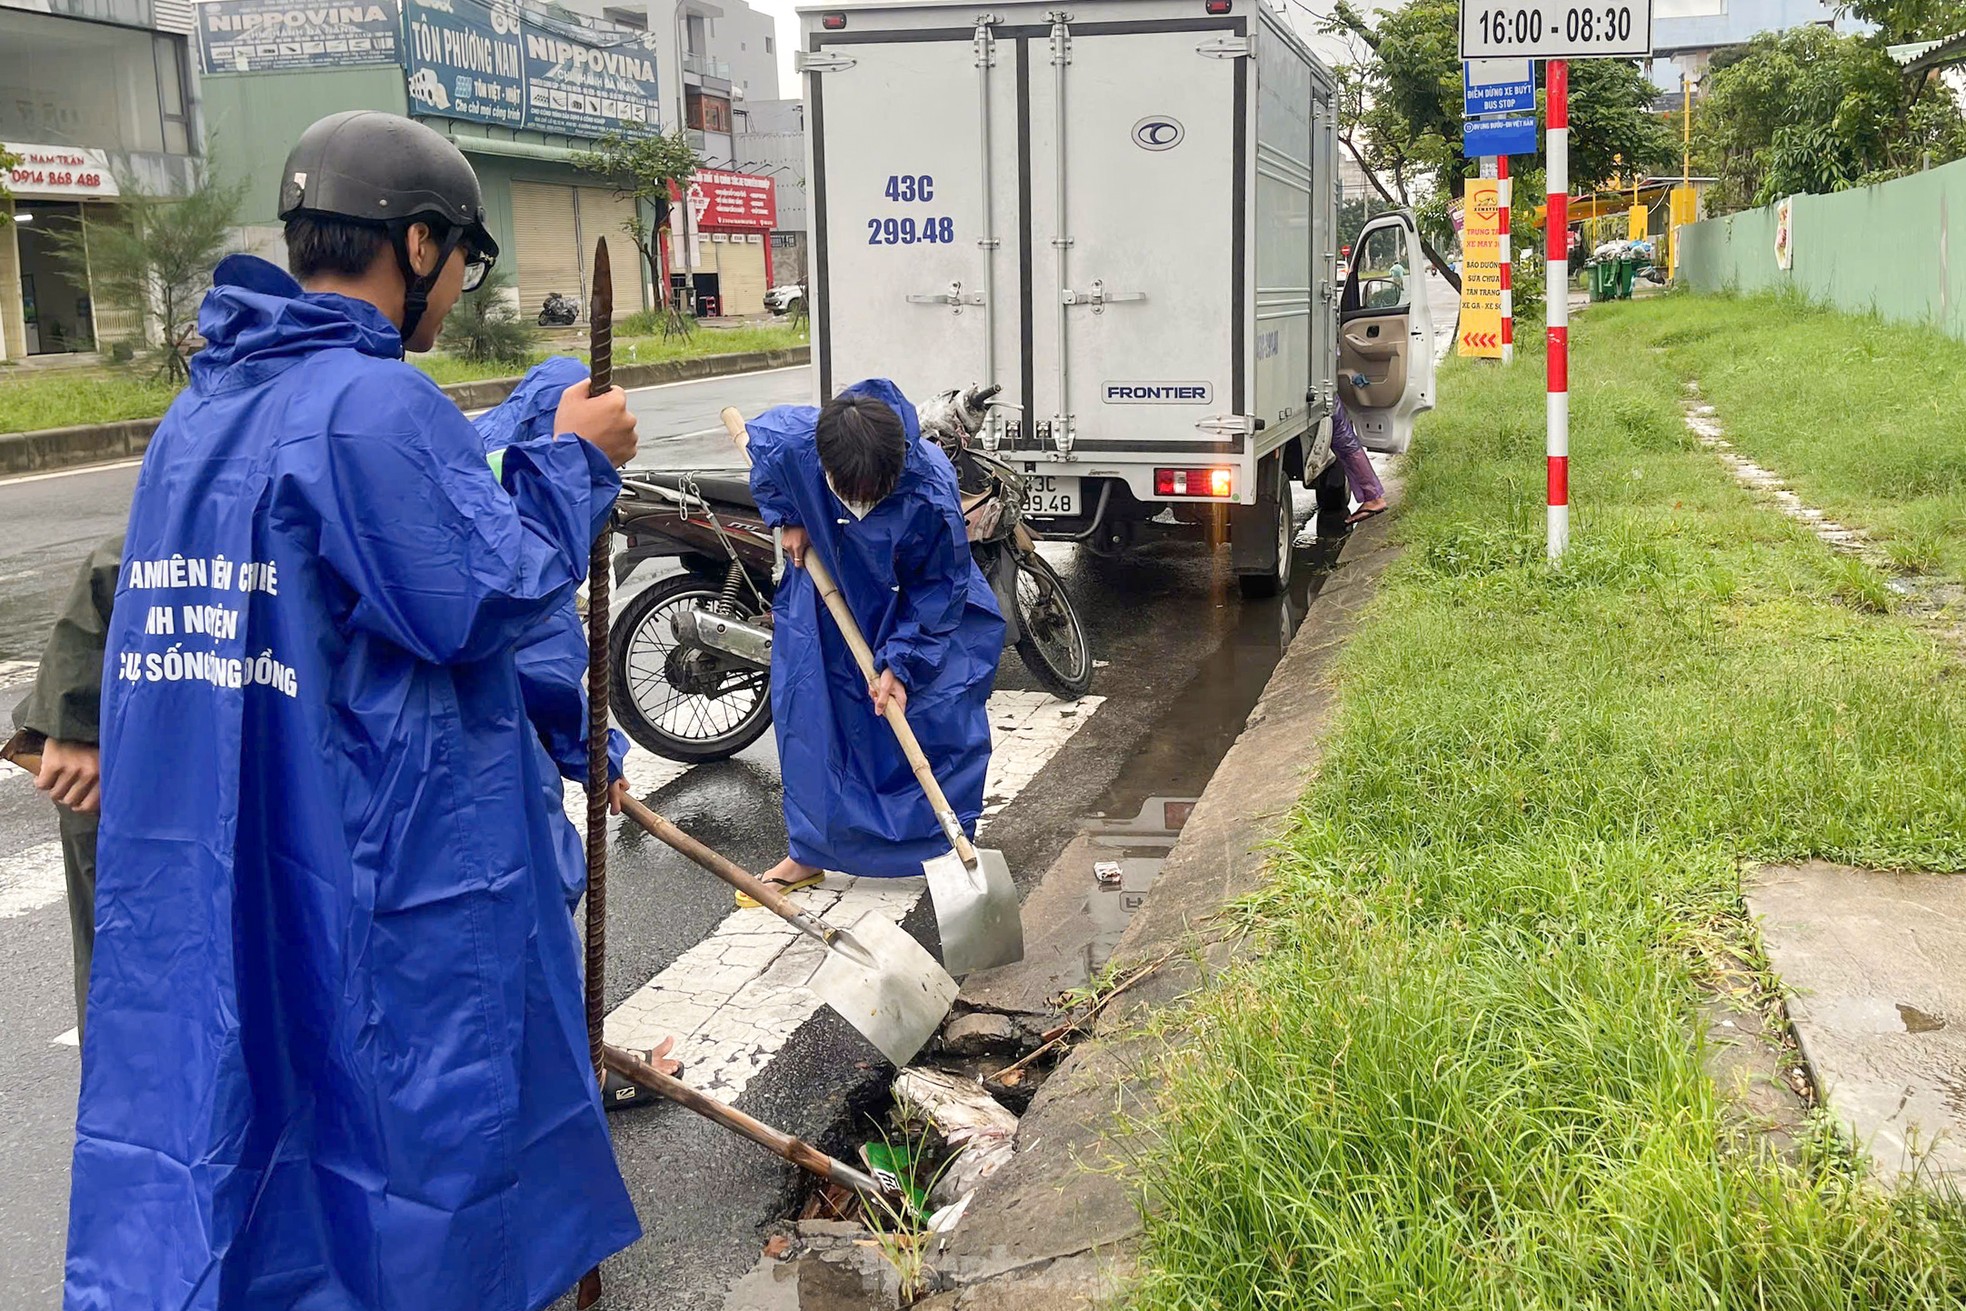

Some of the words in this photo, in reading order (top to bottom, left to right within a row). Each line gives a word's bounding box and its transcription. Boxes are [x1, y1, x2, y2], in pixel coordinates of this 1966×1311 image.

[207, 5, 388, 32] NIPPOVINA
[1479, 9, 1542, 45] 16:00
[1551, 26, 1559, 34] -
[1566, 6, 1631, 43] 08:30
[411, 13, 442, 64] TÔN
[443, 26, 494, 74] PHƯƠNG
[494, 40, 519, 79] NAM
[526, 33, 656, 83] NIPPOVINA
[1504, 86, 1513, 96] XE
[1514, 82, 1532, 95] BUÝT
[1484, 100, 1498, 110] BUS
[1499, 98, 1516, 109] STOP
[12, 169, 44, 184] 0914
[48, 171, 72, 186] 868
[77, 173, 101, 187] 488
[885, 175, 934, 202] 43C
[868, 216, 954, 245] 299.48
[1467, 228, 1490, 236] TRUNG
[1466, 240, 1476, 248] XE
[1479, 288, 1501, 297] TRANG
[1471, 302, 1480, 310] GA
[1485, 302, 1494, 310] XE
[1107, 386, 1206, 399] FRONTIER
[1022, 495, 1071, 512] 99.48
